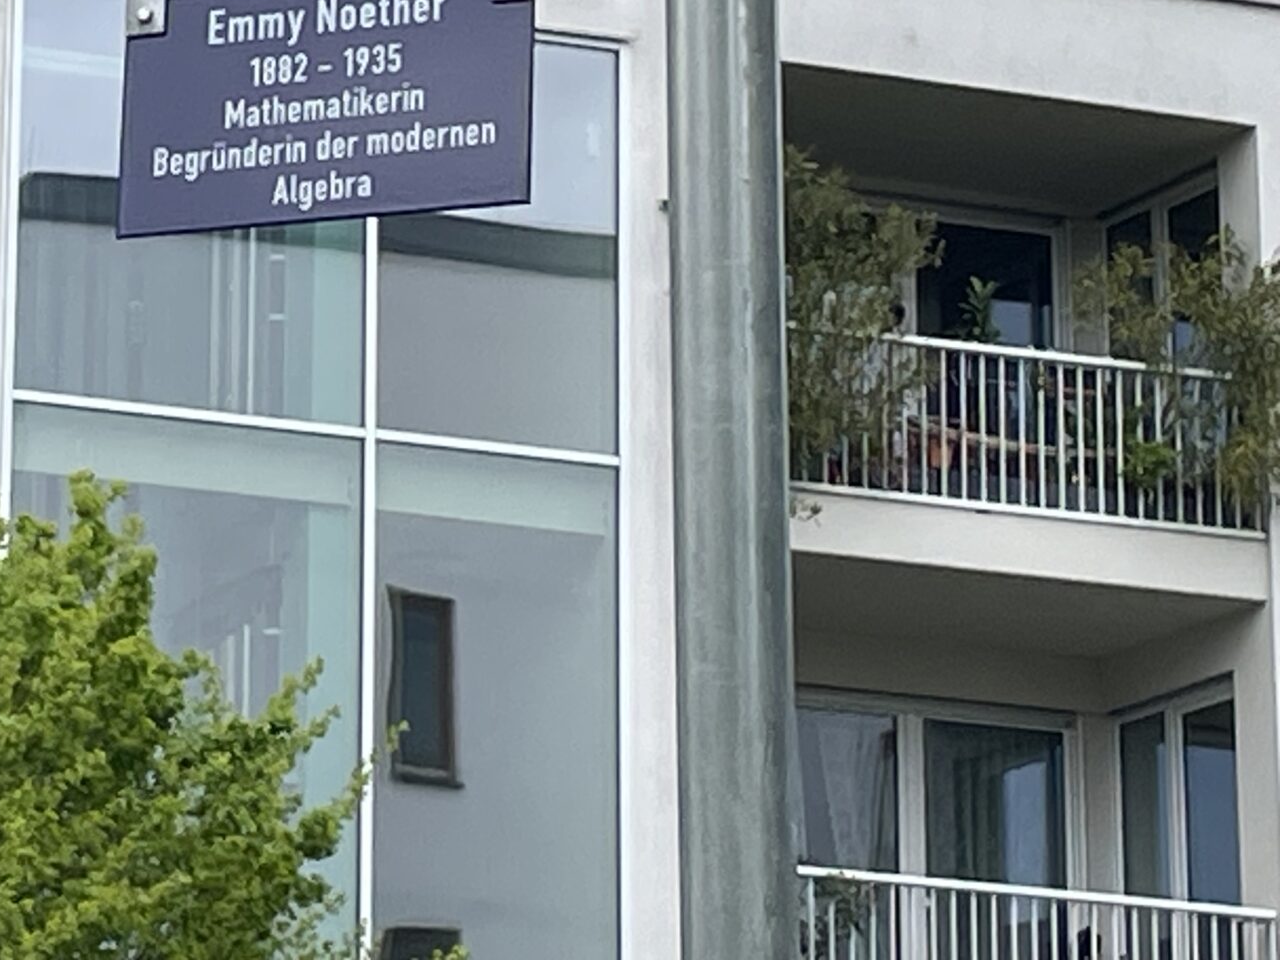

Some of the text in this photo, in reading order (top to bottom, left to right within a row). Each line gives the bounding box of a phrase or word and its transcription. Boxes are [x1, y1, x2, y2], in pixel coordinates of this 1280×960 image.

[207, 7, 306, 47] Emmy
[250, 51, 308, 86] 1882
[344, 43, 403, 77] 1935
[224, 82, 425, 130] Mathematikerin
[153, 119, 496, 182] Begründerin der modernen
[272, 170, 373, 212] Algebra
